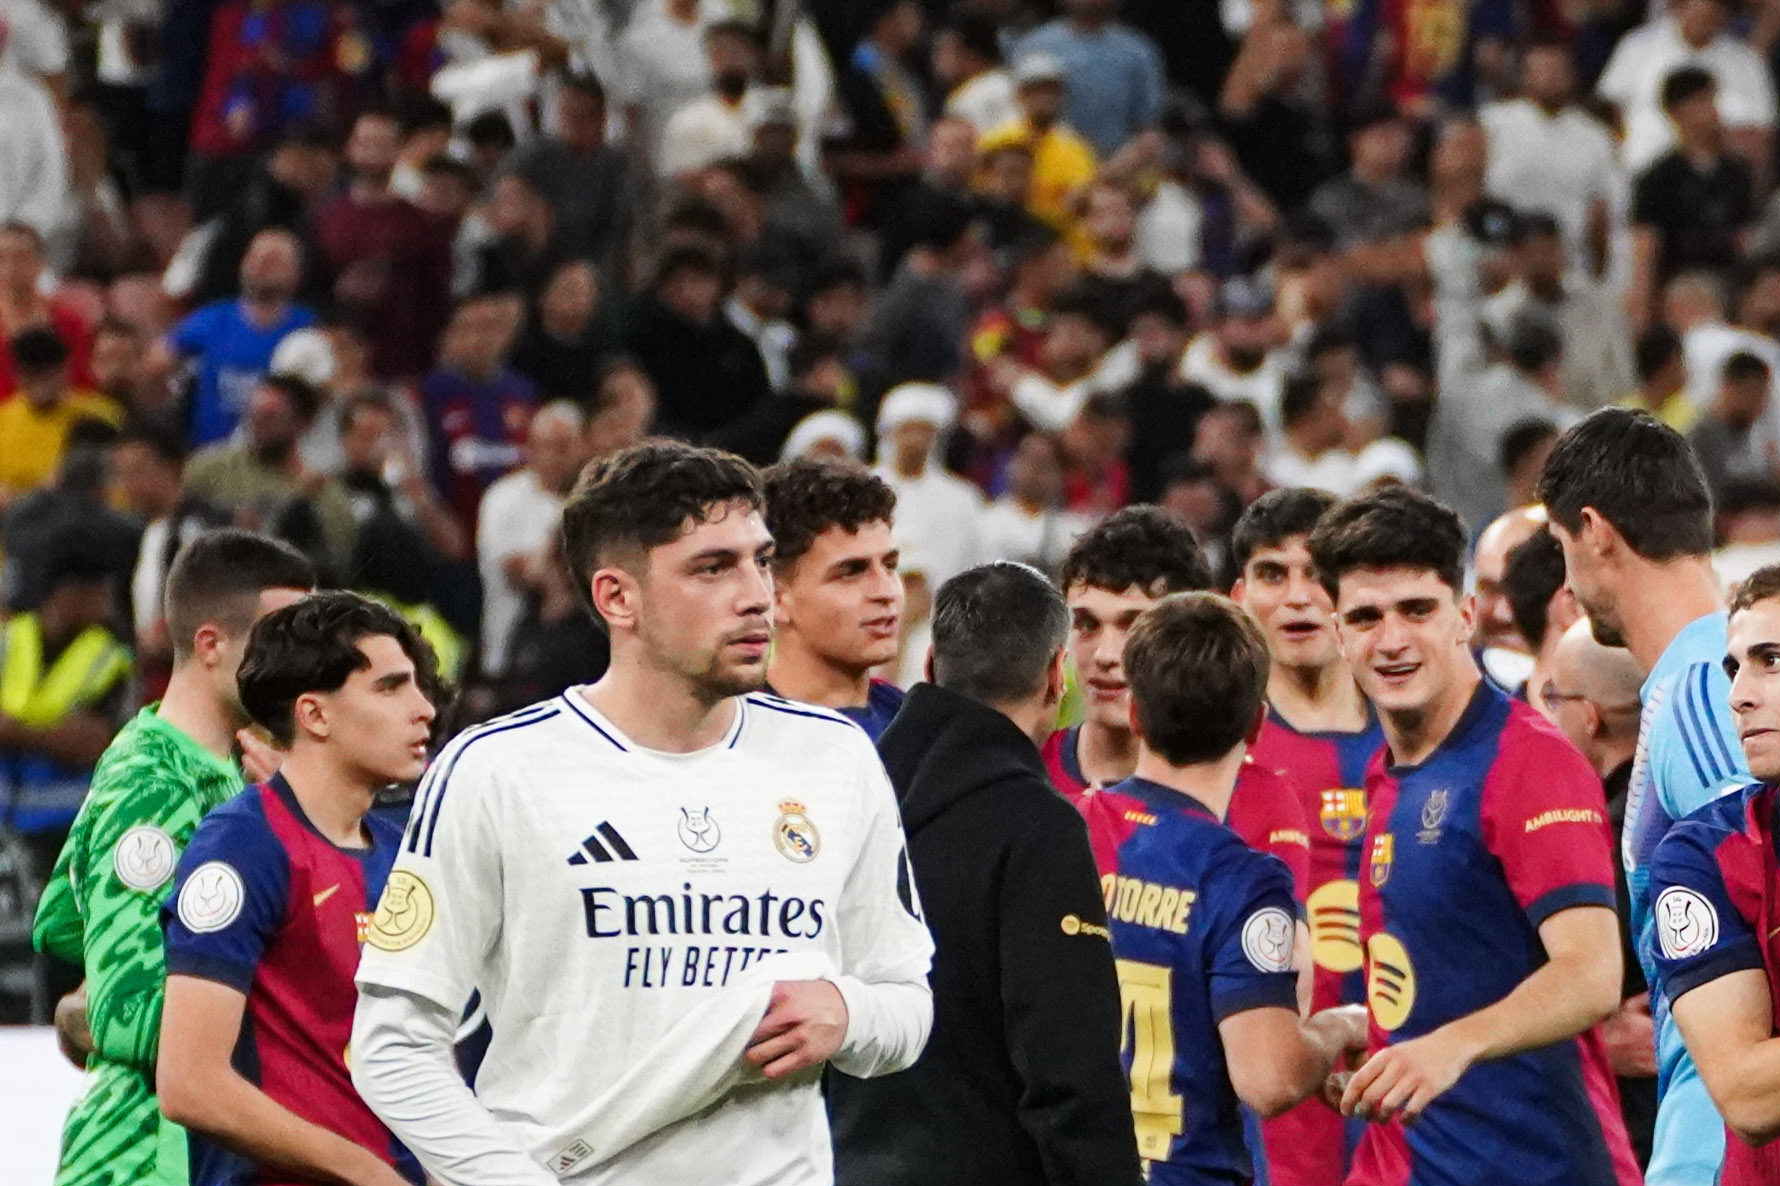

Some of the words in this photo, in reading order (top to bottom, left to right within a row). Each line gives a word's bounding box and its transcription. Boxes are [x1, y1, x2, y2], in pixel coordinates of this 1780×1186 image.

[1525, 808, 1592, 833] AMBILIGHT
[579, 882, 825, 939] Emirates
[1112, 876, 1196, 935] TORRE
[624, 947, 673, 988] FLY
[681, 946, 790, 988] BETT
